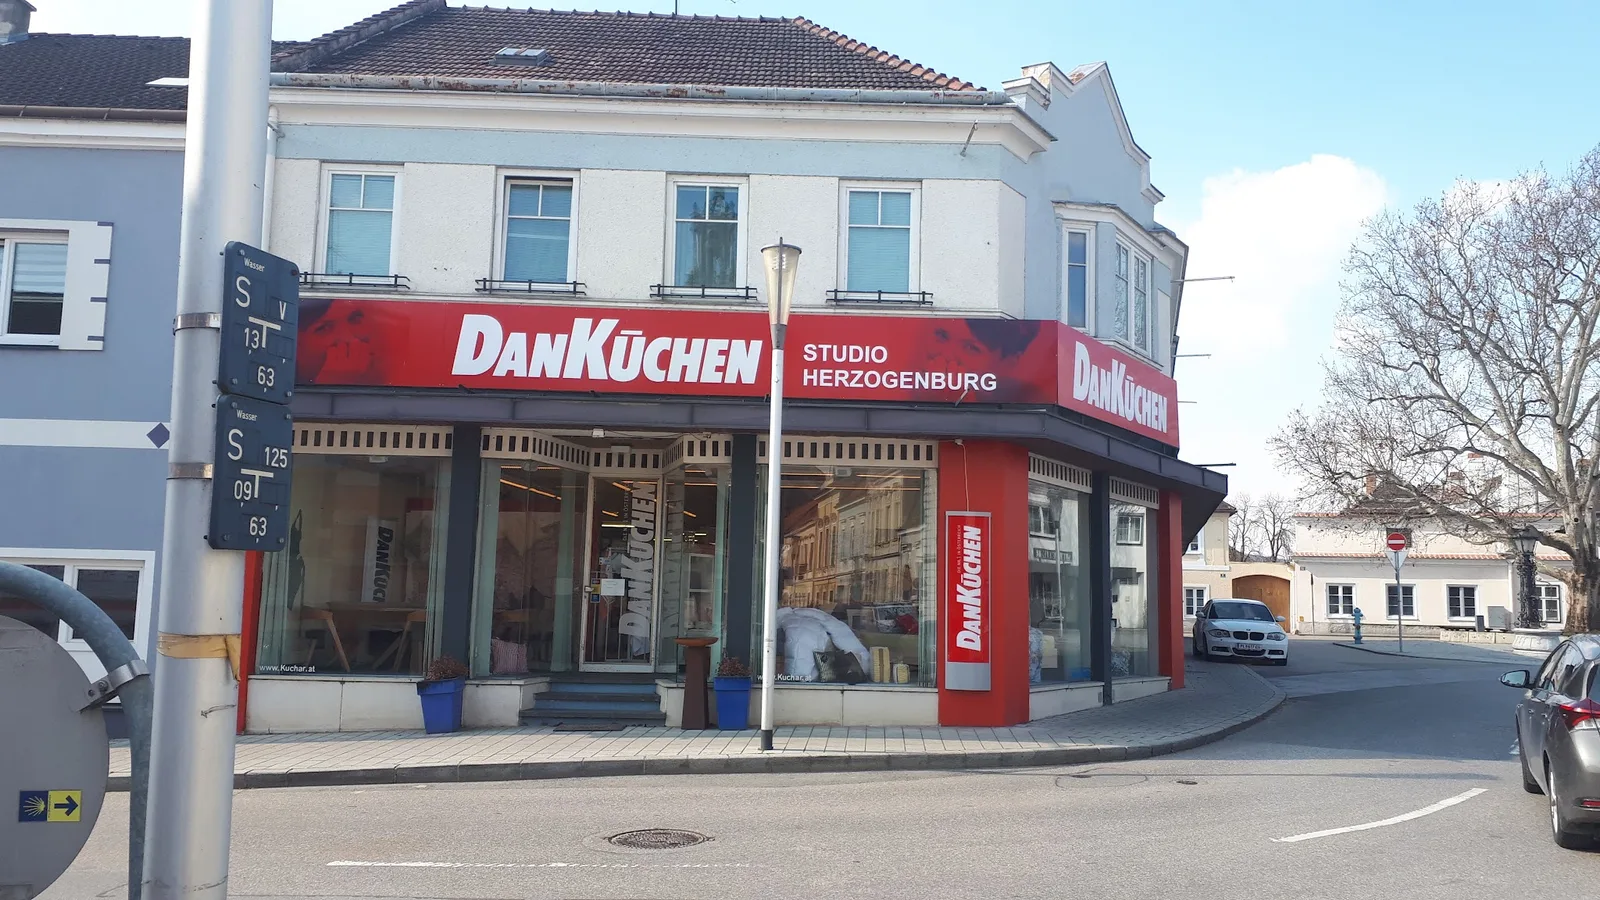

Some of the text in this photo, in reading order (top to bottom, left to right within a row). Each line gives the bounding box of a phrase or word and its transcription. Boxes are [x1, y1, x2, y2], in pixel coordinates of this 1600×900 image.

[244, 257, 265, 273] Wasser
[235, 275, 251, 308] S
[279, 301, 287, 320] V
[803, 343, 888, 364] STUDIO
[802, 368, 997, 392] HERZOGENBURG
[236, 409, 258, 422] Wasser
[227, 428, 244, 460] S
[264, 446, 288, 469] 125
[259, 664, 316, 673] www.Kuchar.at
